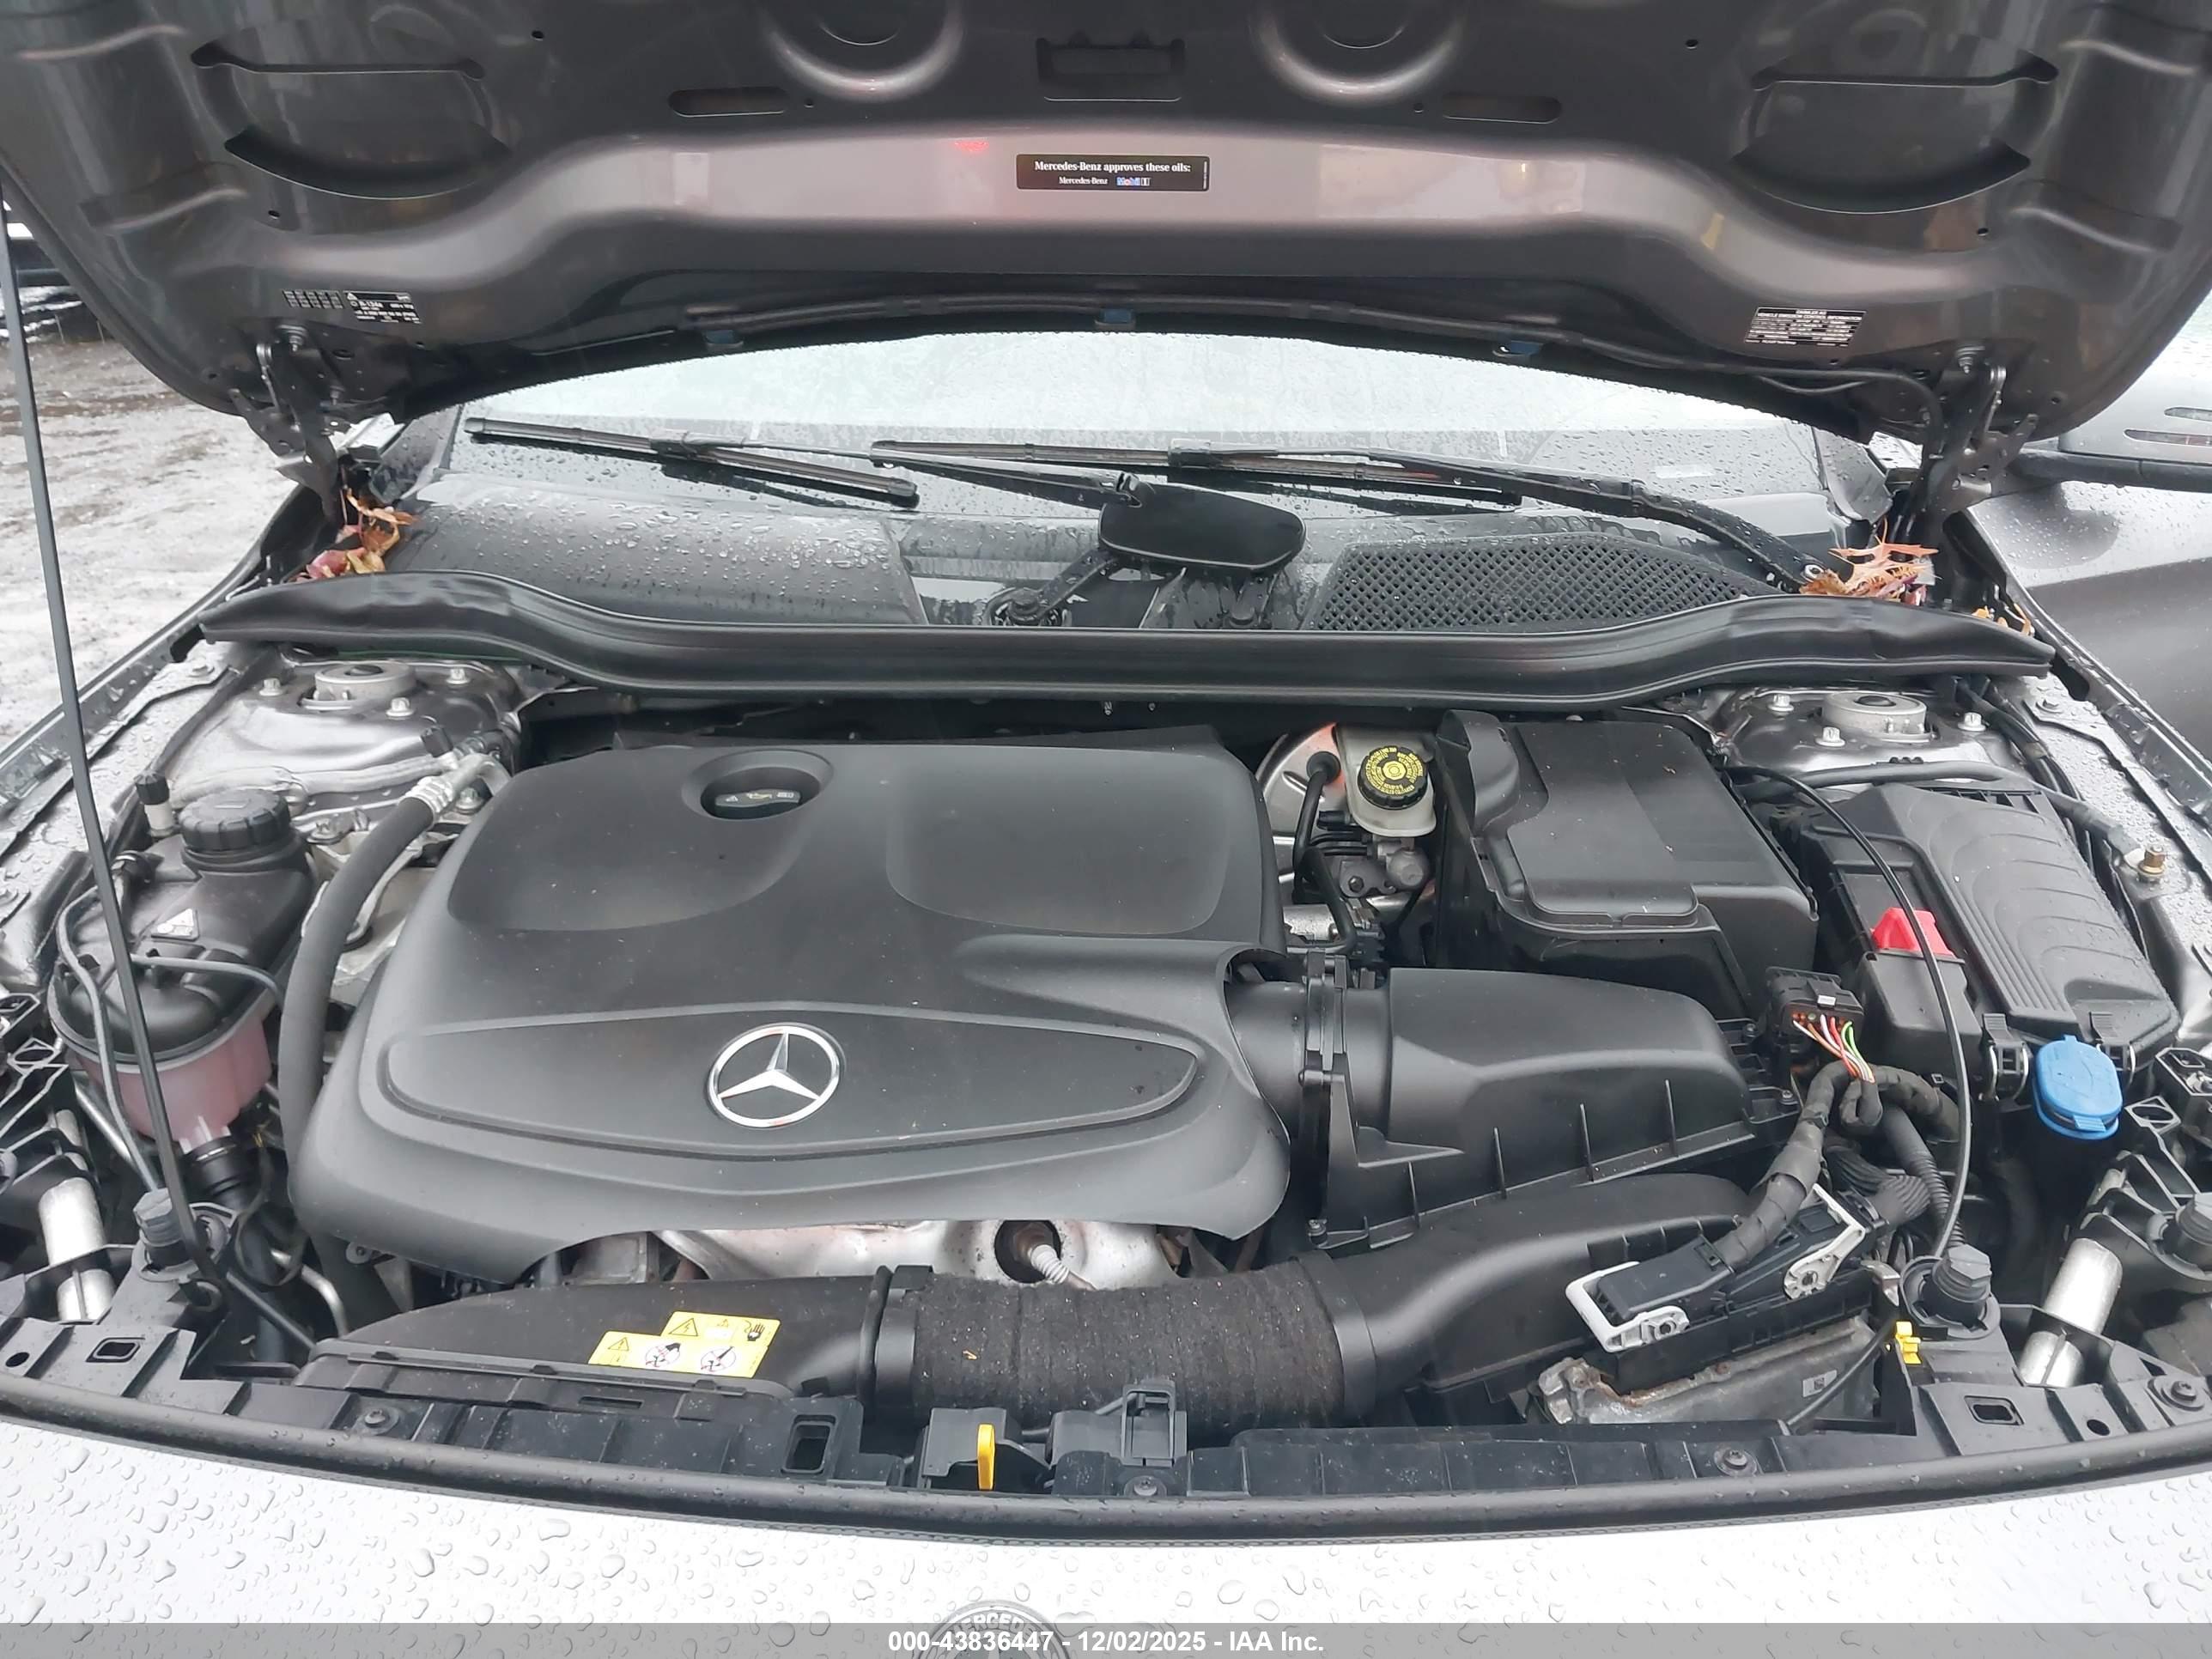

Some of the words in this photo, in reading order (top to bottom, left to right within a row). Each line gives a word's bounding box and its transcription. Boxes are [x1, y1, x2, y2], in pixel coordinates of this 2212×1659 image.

[1034, 161, 1102, 171] Mercedes-Benz
[1103, 163, 1145, 173] approves
[1146, 162, 1170, 172] these
[1171, 162, 1192, 172] oils:
